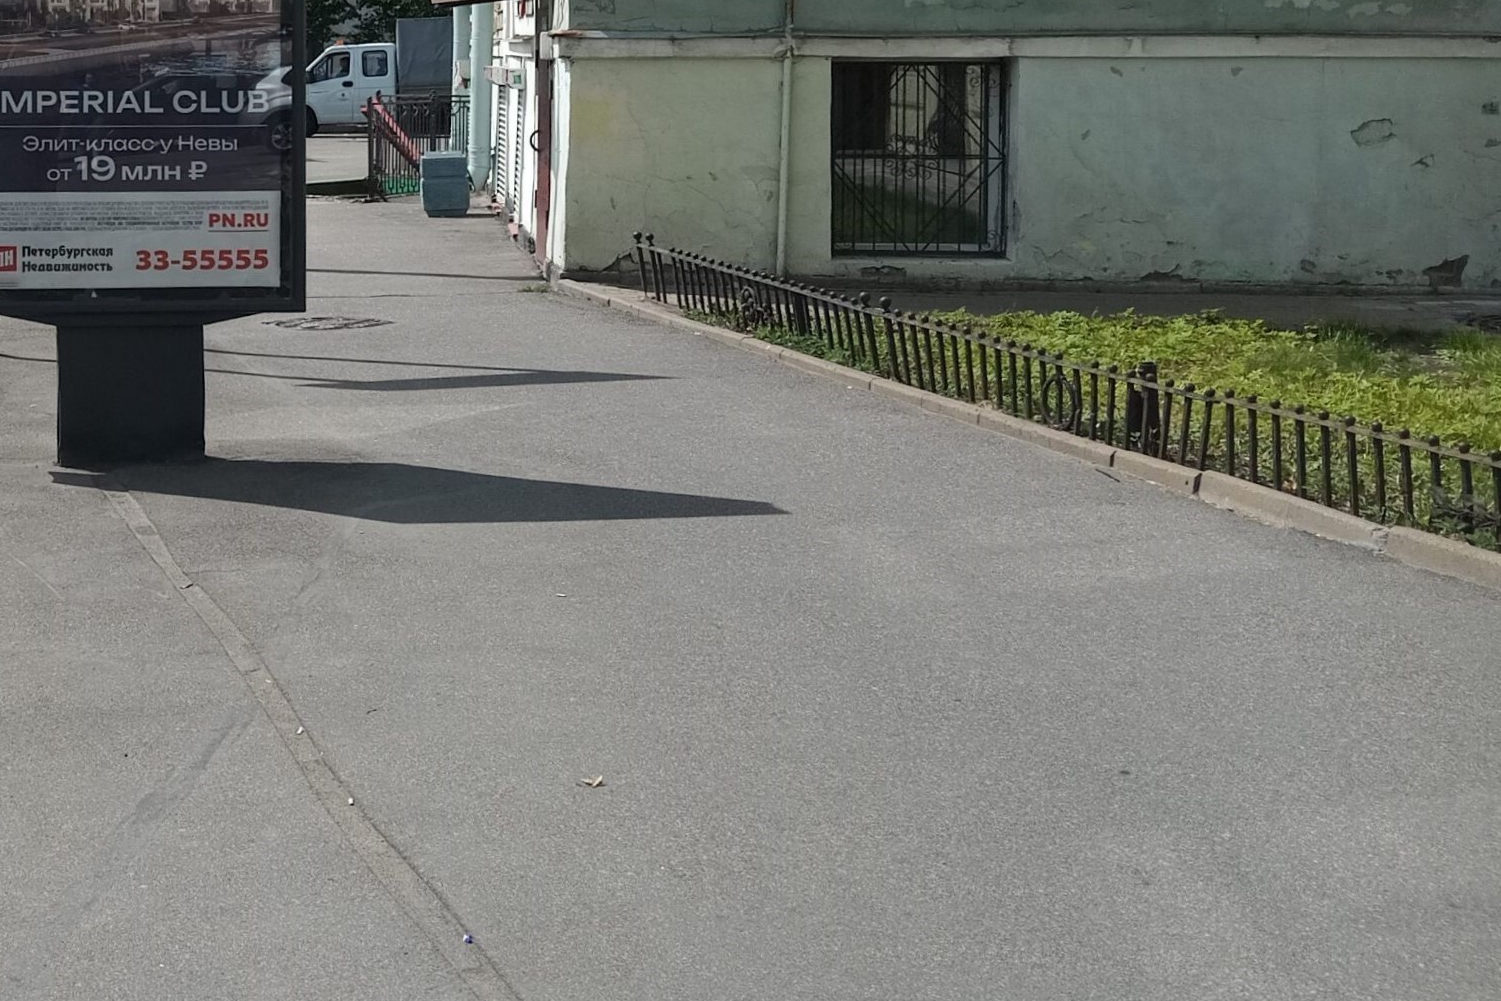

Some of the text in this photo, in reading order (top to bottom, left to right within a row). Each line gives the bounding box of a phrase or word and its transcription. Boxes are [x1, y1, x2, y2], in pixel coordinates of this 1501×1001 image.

[172, 90, 270, 114] CLUB
[22, 135, 238, 154] Элит-класс у Невы
[46, 168, 72, 181] от
[74, 156, 116, 182] 19
[121, 165, 181, 181] млн
[209, 213, 270, 229] PN.RU
[22, 246, 113, 261] Петербургская
[135, 250, 270, 271] 33-55555
[22, 260, 114, 273] Недвижимость
